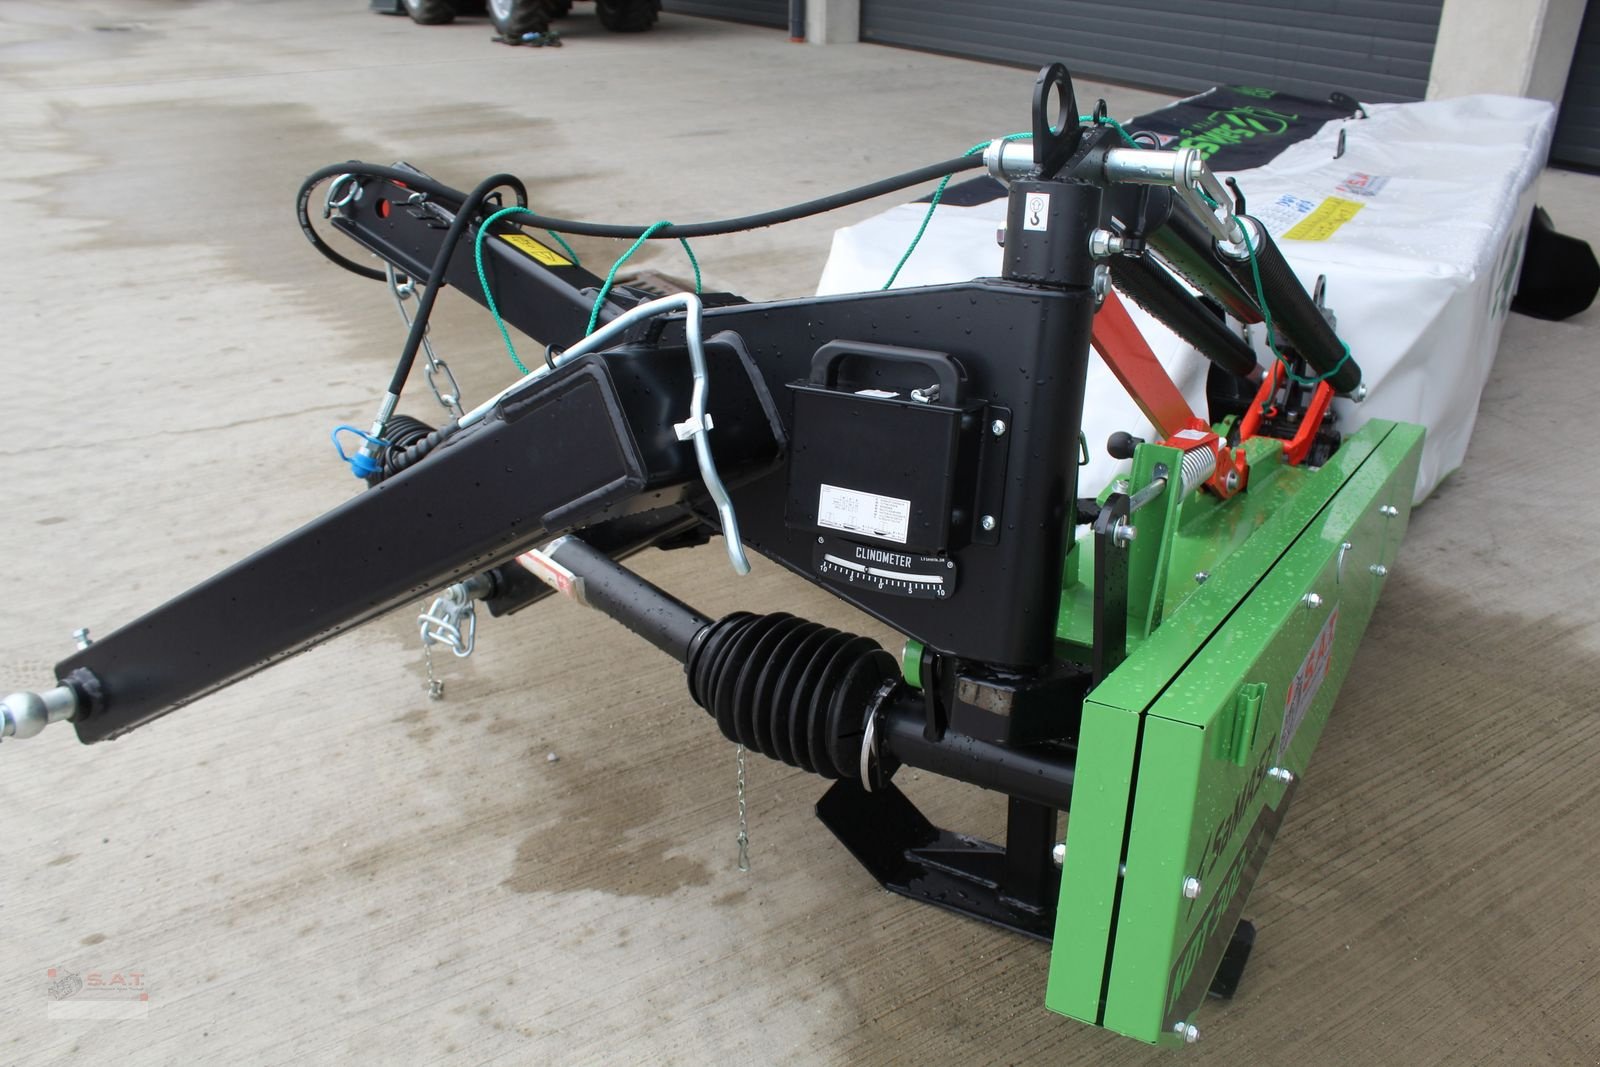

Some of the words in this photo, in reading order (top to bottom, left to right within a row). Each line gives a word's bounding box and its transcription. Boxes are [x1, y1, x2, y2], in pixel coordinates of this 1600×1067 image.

[1172, 123, 1256, 161] SaMAS
[855, 547, 912, 568] CLINOMETER
[820, 565, 828, 573] 10
